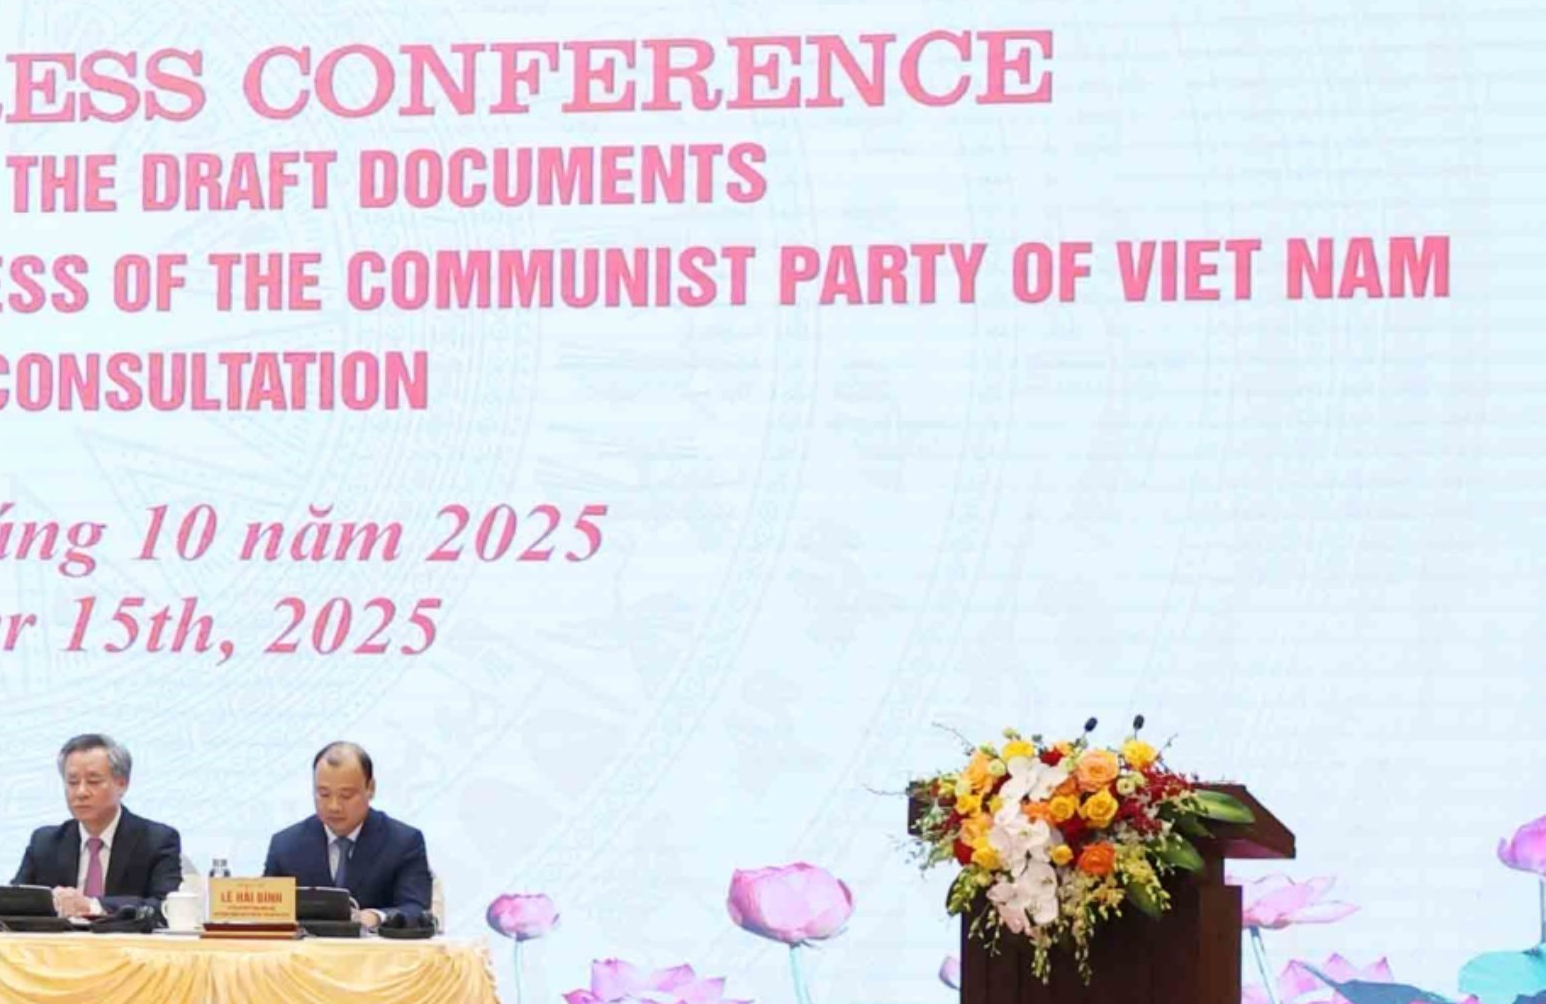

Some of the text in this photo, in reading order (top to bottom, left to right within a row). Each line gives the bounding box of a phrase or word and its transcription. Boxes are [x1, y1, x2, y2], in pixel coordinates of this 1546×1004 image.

[242, 29, 1054, 121] CONFERENCE
[7, 153, 116, 213] THE
[141, 150, 336, 211] DRAFT
[359, 141, 767, 209] DOCUMENTS
[113, 252, 186, 314] OF
[208, 251, 321, 311] THE
[346, 244, 755, 311] COMMUNIST
[778, 241, 985, 306] PARTY
[1011, 240, 1091, 304] OF
[1115, 237, 1262, 303] VIET
[1285, 234, 1450, 301] NAM
[139, 504, 218, 561] 10
[239, 503, 403, 562] năm
[425, 503, 609, 562] 2025
[60, 596, 235, 666] 15th,
[265, 596, 443, 656] 2025
